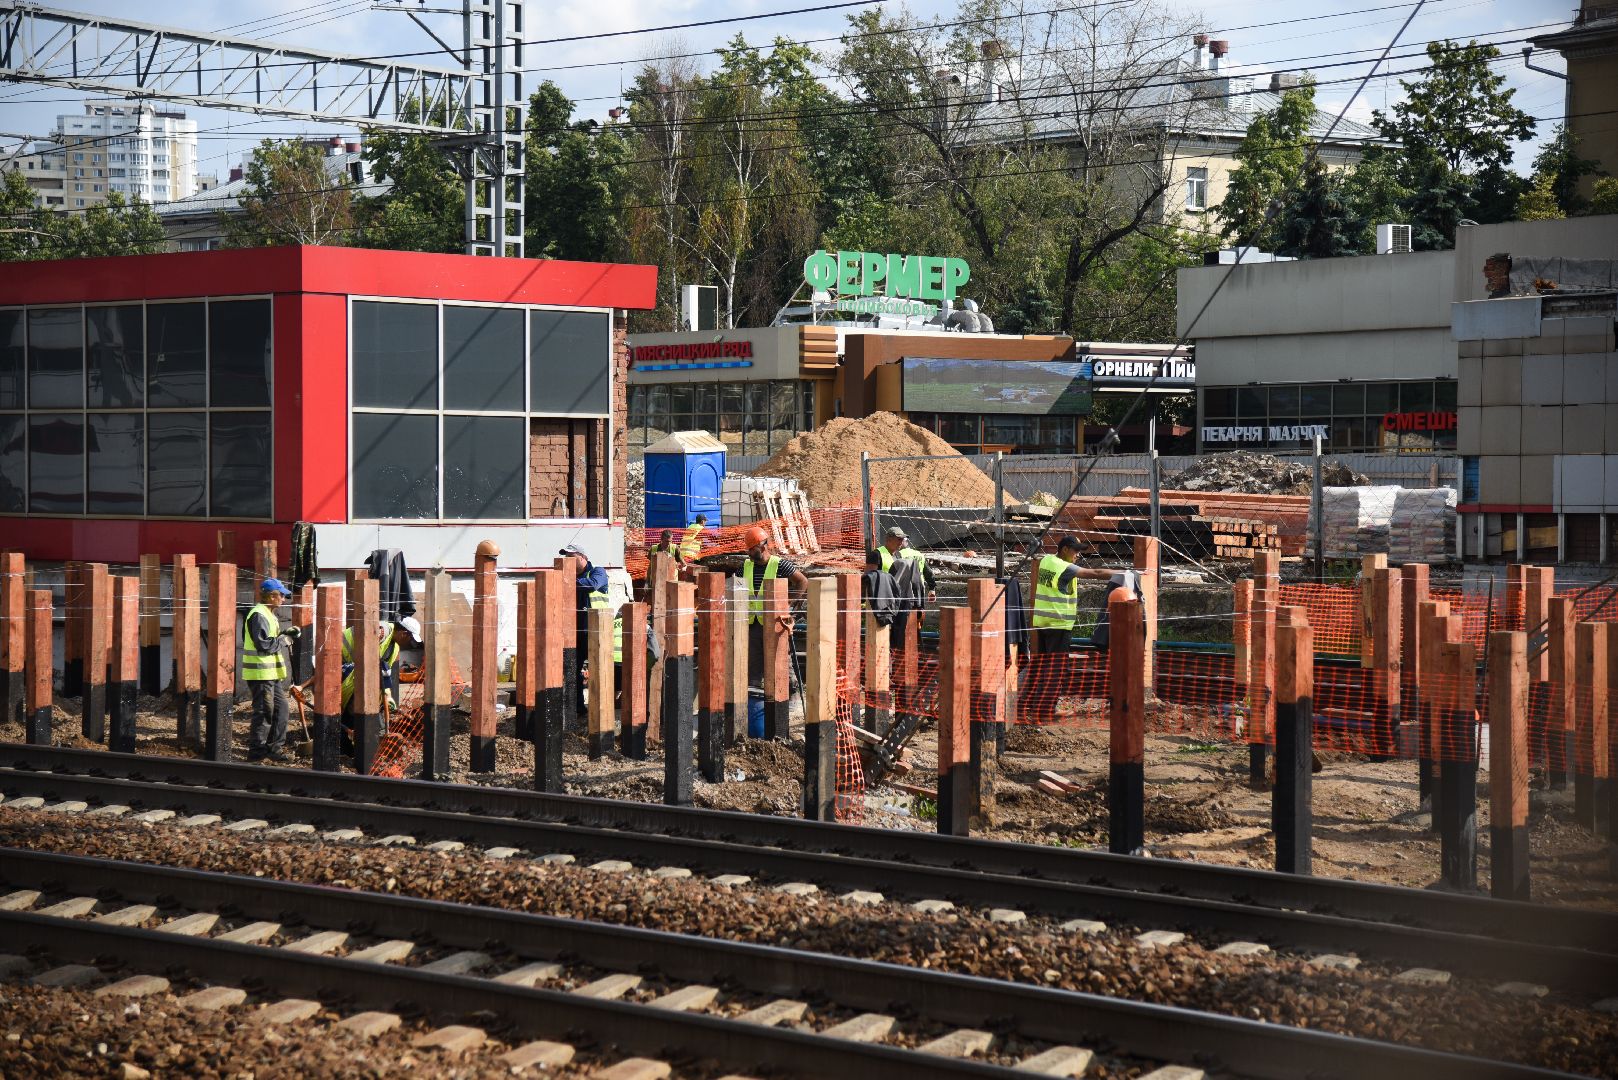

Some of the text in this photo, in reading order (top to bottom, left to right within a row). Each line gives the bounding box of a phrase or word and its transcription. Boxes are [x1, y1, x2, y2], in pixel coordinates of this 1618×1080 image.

[804, 250, 971, 300] ФЕРМЕР
[722, 341, 753, 358] РЯД
[1201, 424, 1329, 442] ПЕКАРНЯ МАЯЧОК
